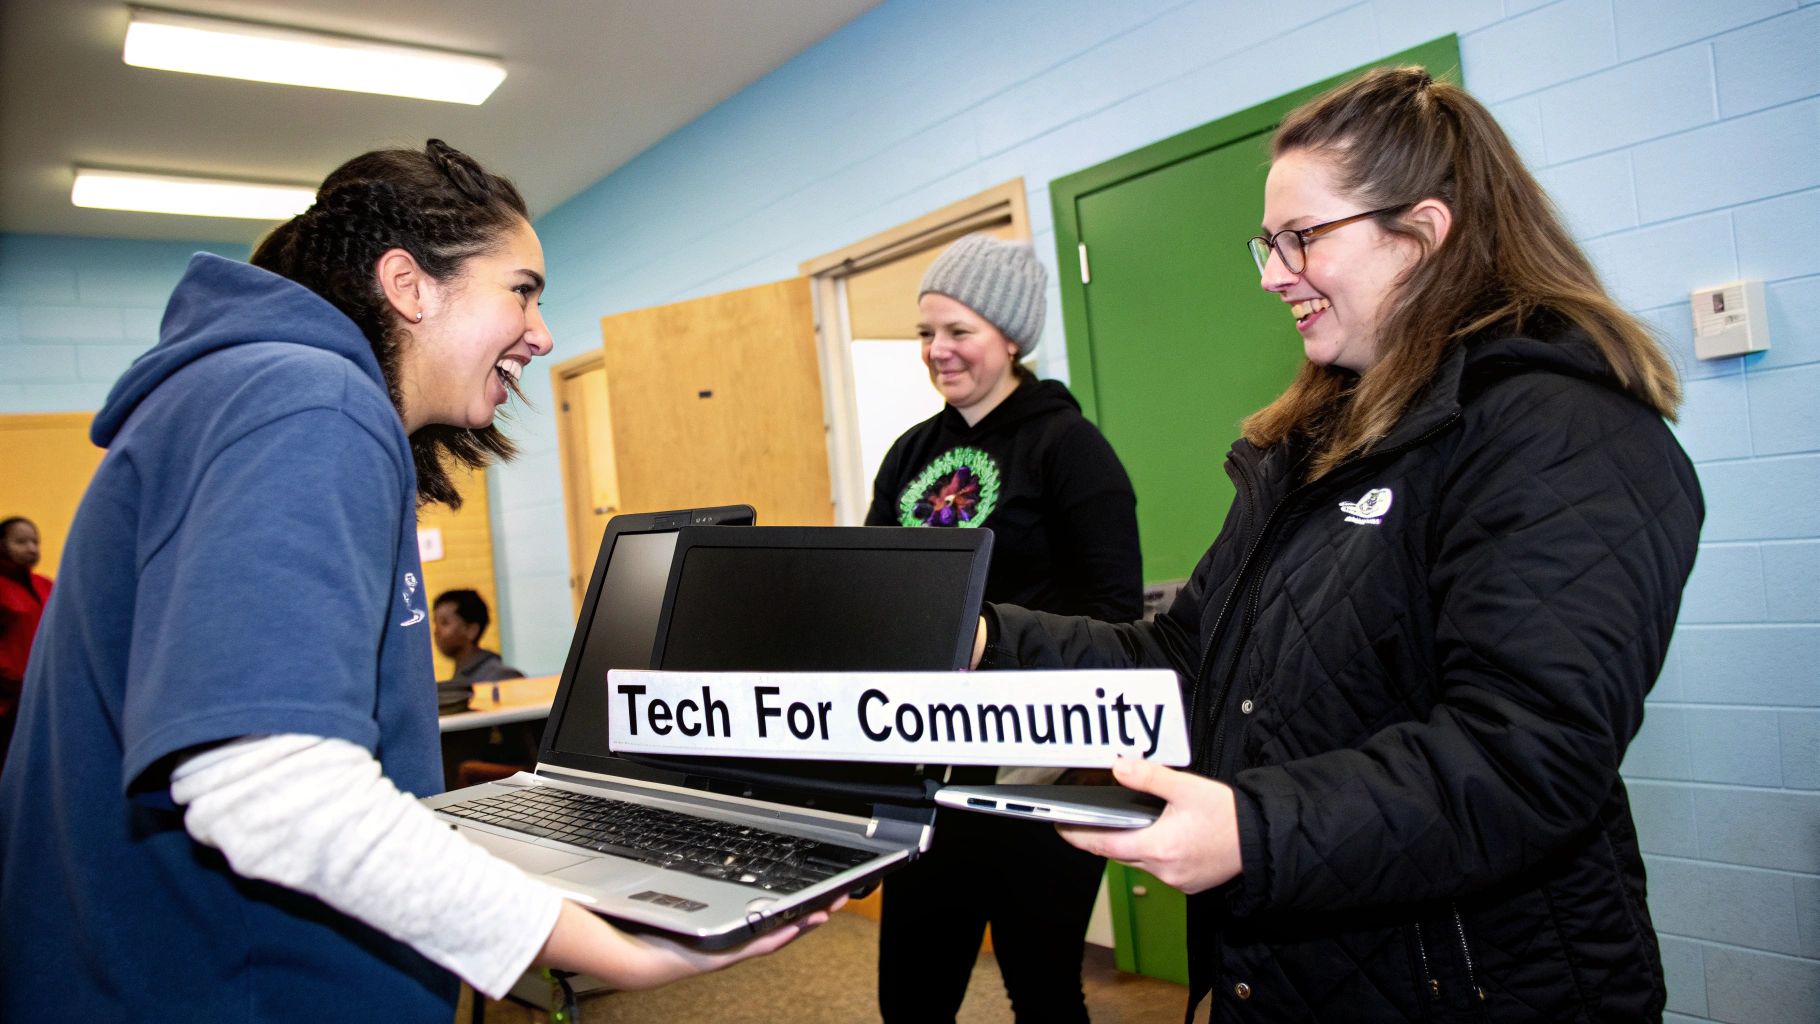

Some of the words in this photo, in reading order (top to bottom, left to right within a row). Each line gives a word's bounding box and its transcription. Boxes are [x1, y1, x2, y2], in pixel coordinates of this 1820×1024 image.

[618, 684, 731, 738] Tech
[754, 685, 832, 741] For
[857, 687, 1165, 759] Community
